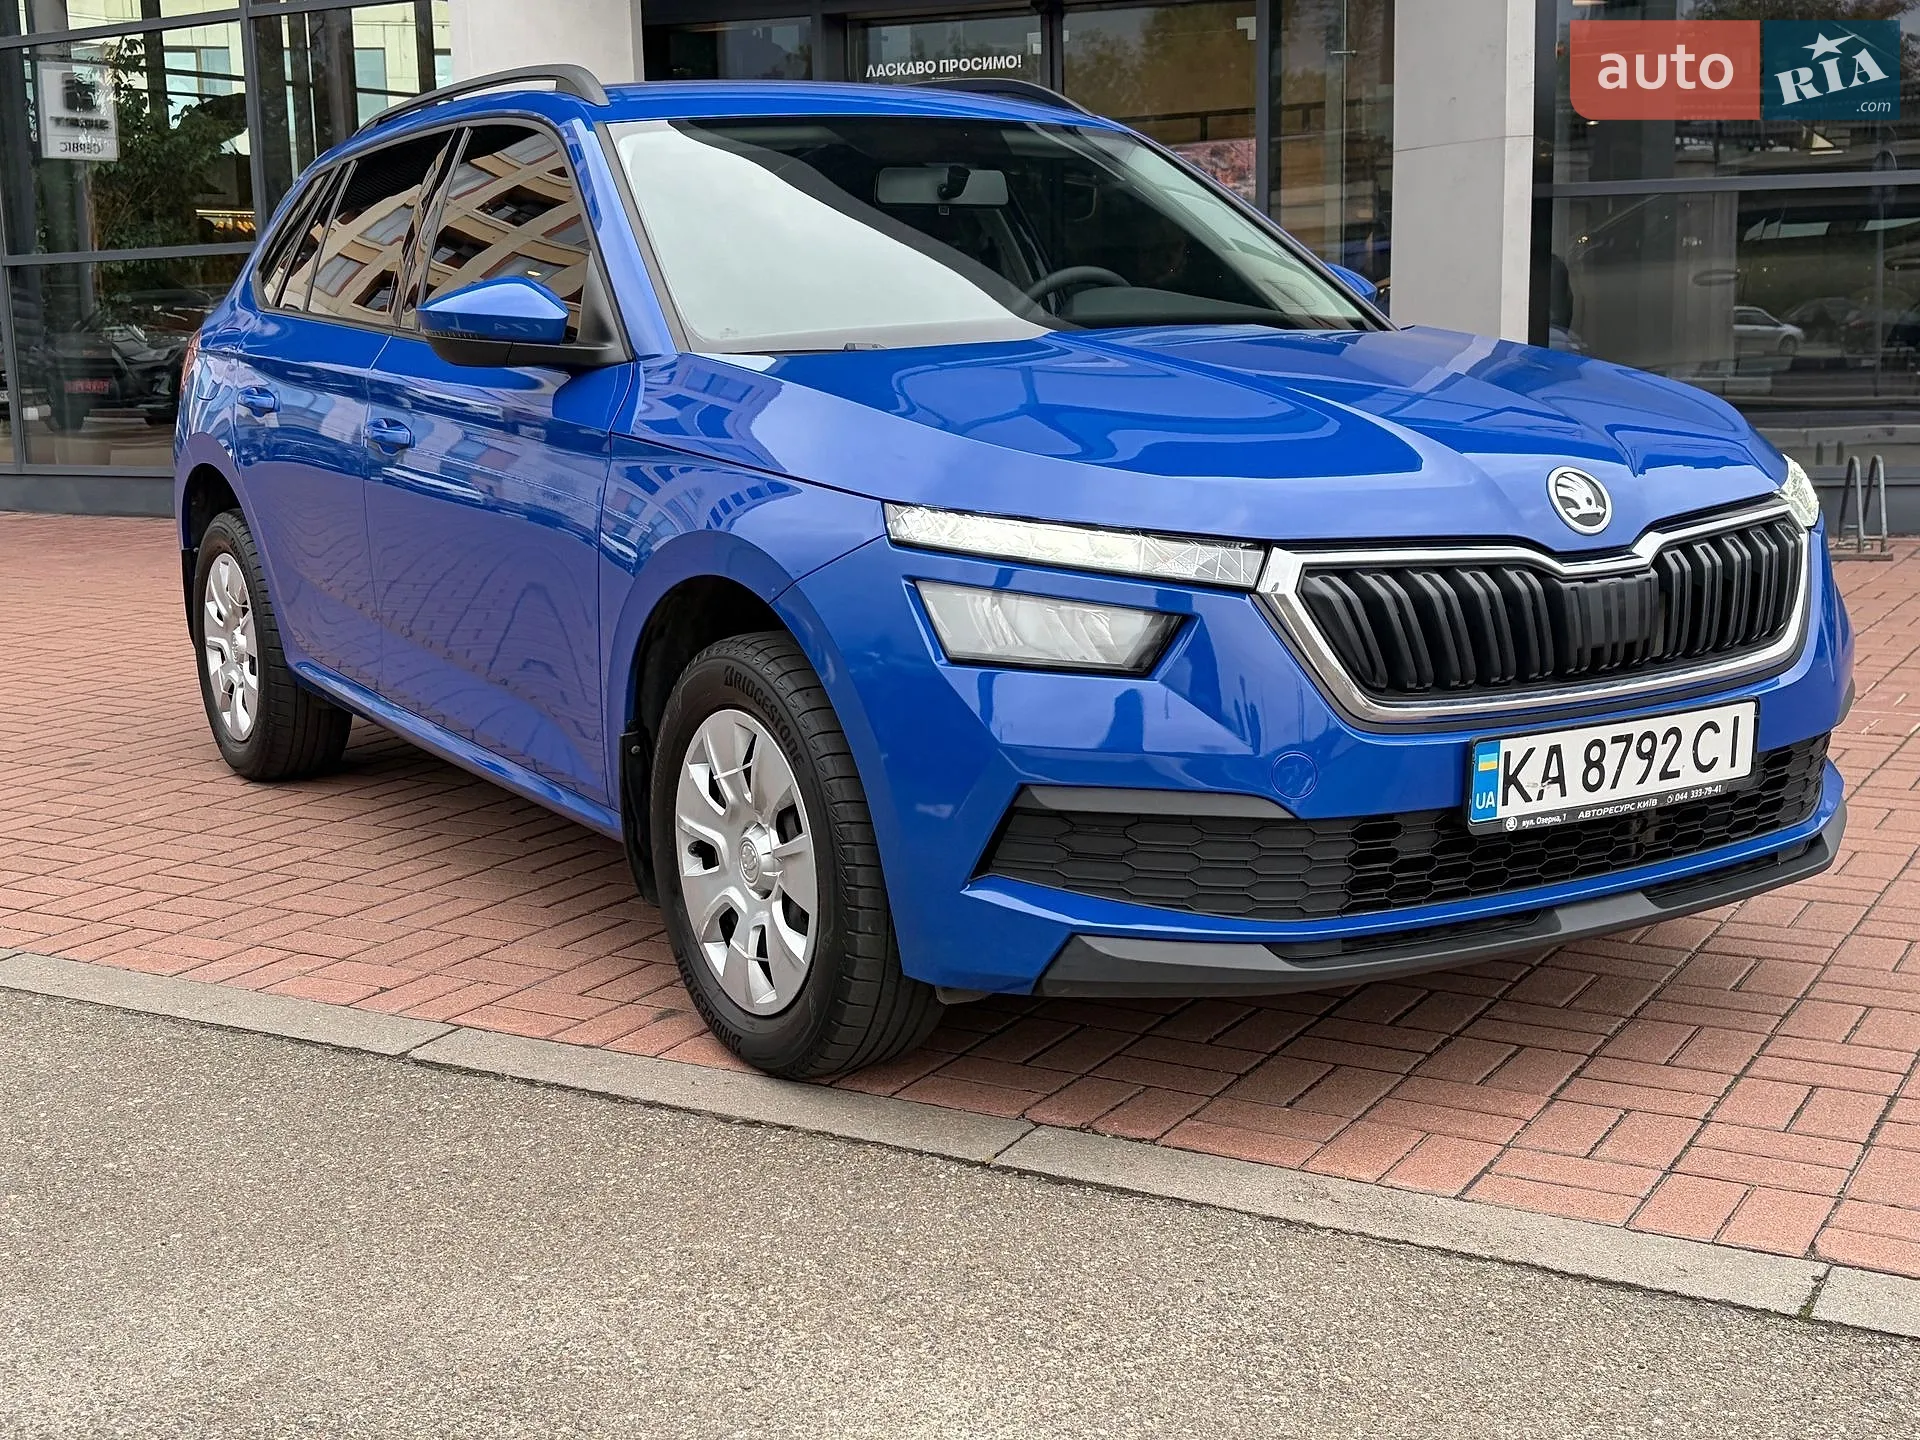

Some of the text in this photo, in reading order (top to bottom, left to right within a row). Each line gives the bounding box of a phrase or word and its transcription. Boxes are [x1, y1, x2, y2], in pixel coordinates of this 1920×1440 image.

[865, 54, 1022, 78] ЛАСКАВО ПРОСИМО!
[1501, 715, 1740, 807] KA 8792 CI
[1475, 790, 1496, 810] UA
[1674, 784, 1722, 802] 044 333-79-41
[1577, 798, 1658, 819] АВТОРЕСУРС КИЇВ
